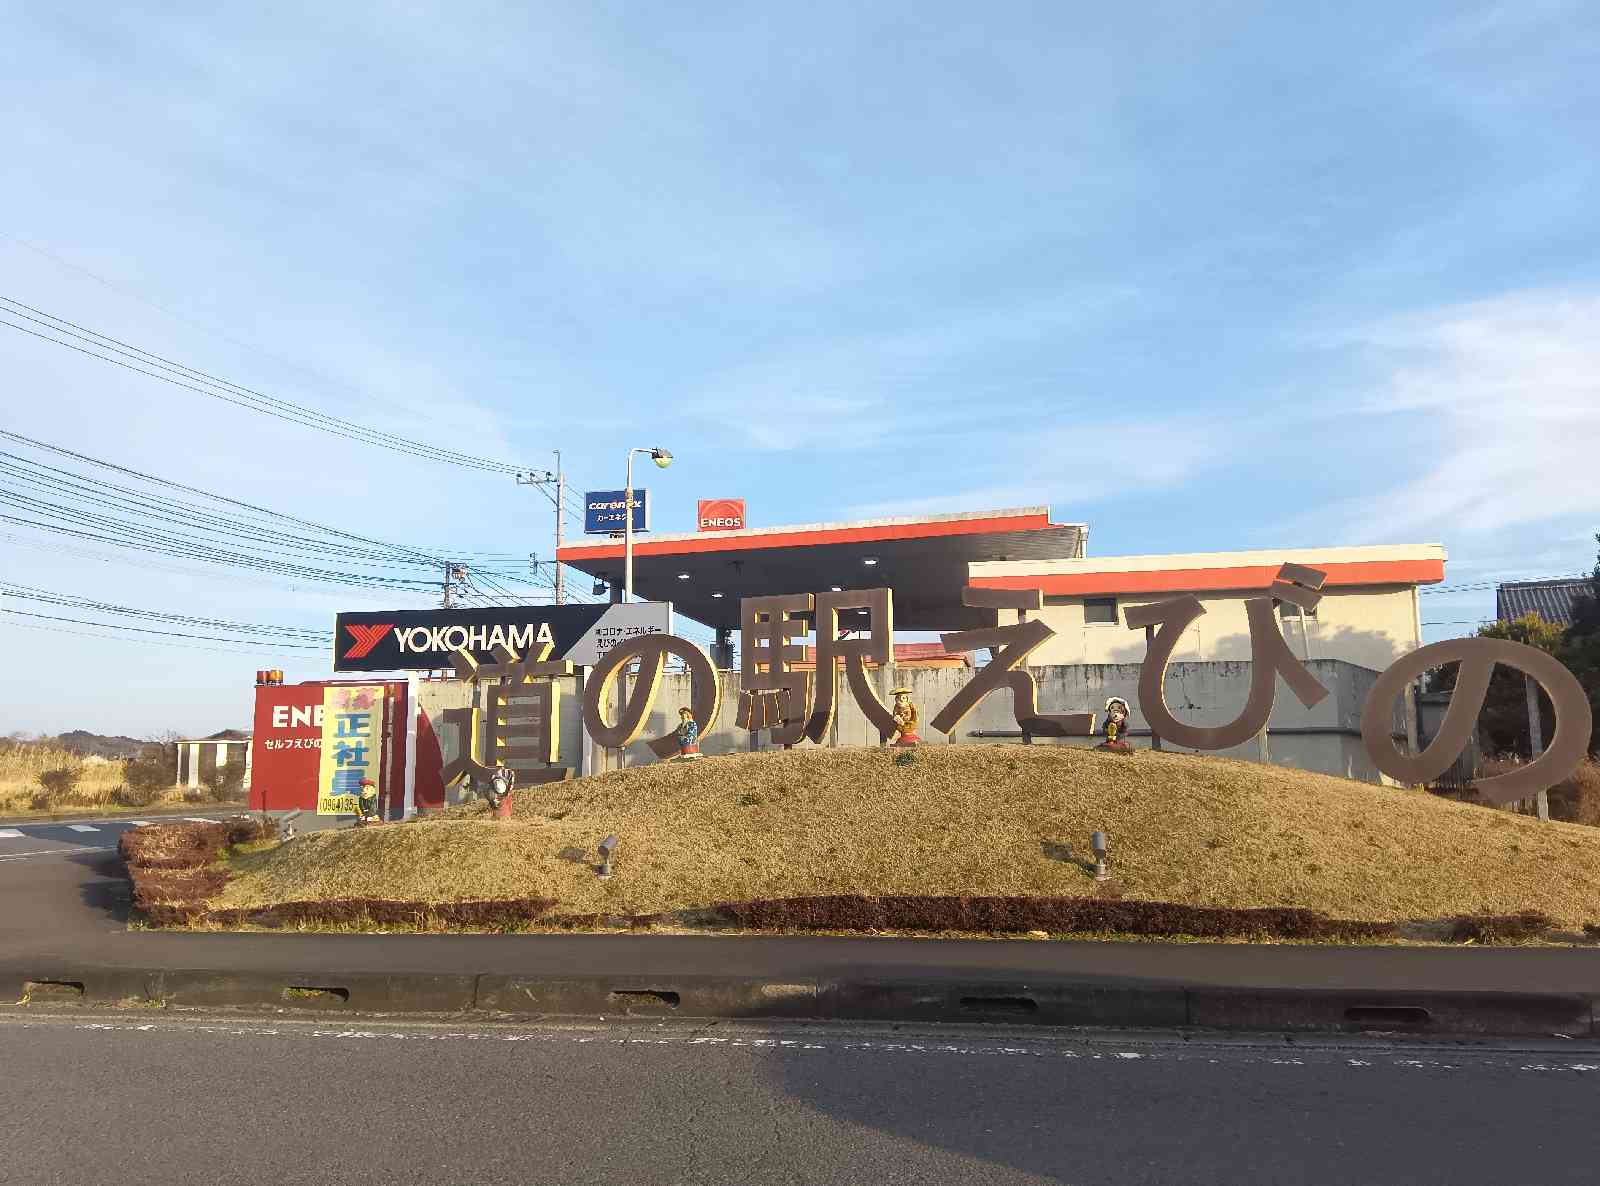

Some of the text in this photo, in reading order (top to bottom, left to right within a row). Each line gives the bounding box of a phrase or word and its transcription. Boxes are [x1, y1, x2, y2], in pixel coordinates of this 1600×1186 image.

[589, 501, 641, 510] carenx
[597, 513, 634, 522] カーエネク
[701, 517, 741, 528] ENEOS
[393, 622, 555, 653] YOKOHAMA
